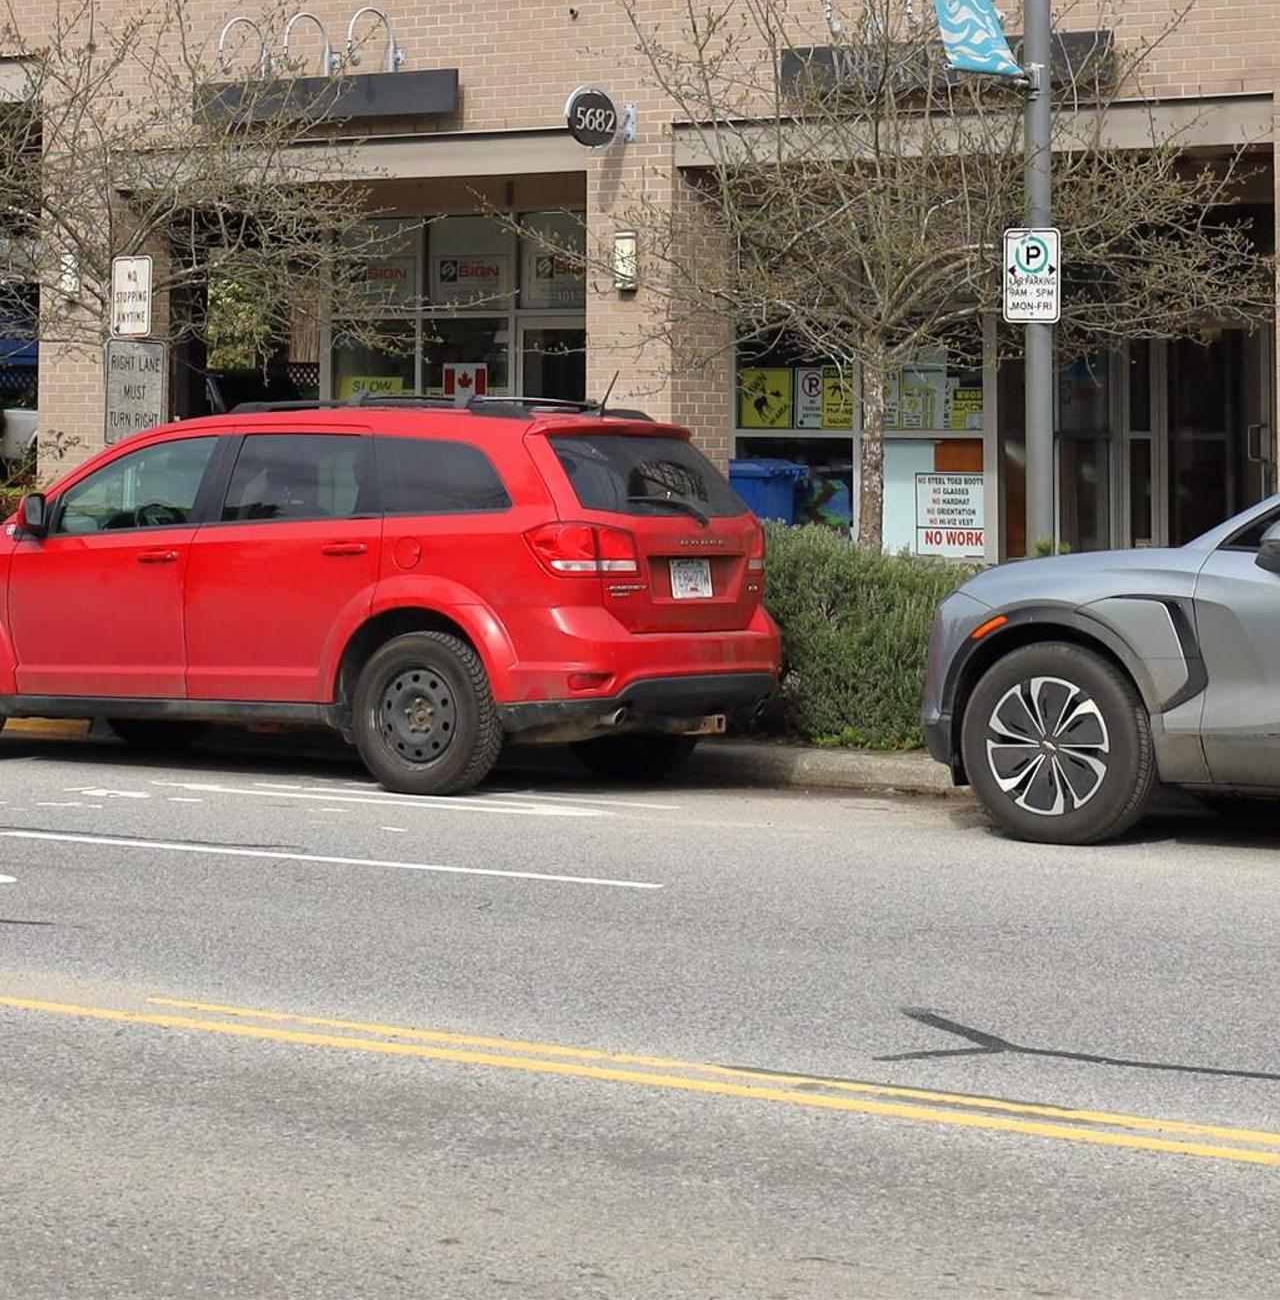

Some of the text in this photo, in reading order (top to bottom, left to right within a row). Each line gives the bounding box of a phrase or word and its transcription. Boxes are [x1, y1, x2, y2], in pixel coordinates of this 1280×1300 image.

[576, 106, 615, 133] 5682
[127, 270, 138, 282] NO
[459, 265, 500, 278] SIGN
[1025, 276, 1056, 285] PARKING
[116, 291, 147, 303] STOPPING
[1010, 288, 1028, 297] 9AM
[1036, 288, 1054, 298] 5PM
[1012, 302, 1053, 311] MON-FRI
[116, 311, 146, 323] ANYTIME
[110, 355, 161, 373] RIGHT LANE
[123, 384, 146, 400] MUST
[110, 411, 159, 428] TURN RIGHT
[928, 477, 946, 485] STEEL
[947, 477, 962, 485] TOED
[933, 487, 969, 495] NO GLASSES
[937, 508, 976, 516] ORIENTATION
[929, 517, 937, 525] NO
[958, 518, 973, 526] VEST
[925, 530, 983, 547] NO WORK
